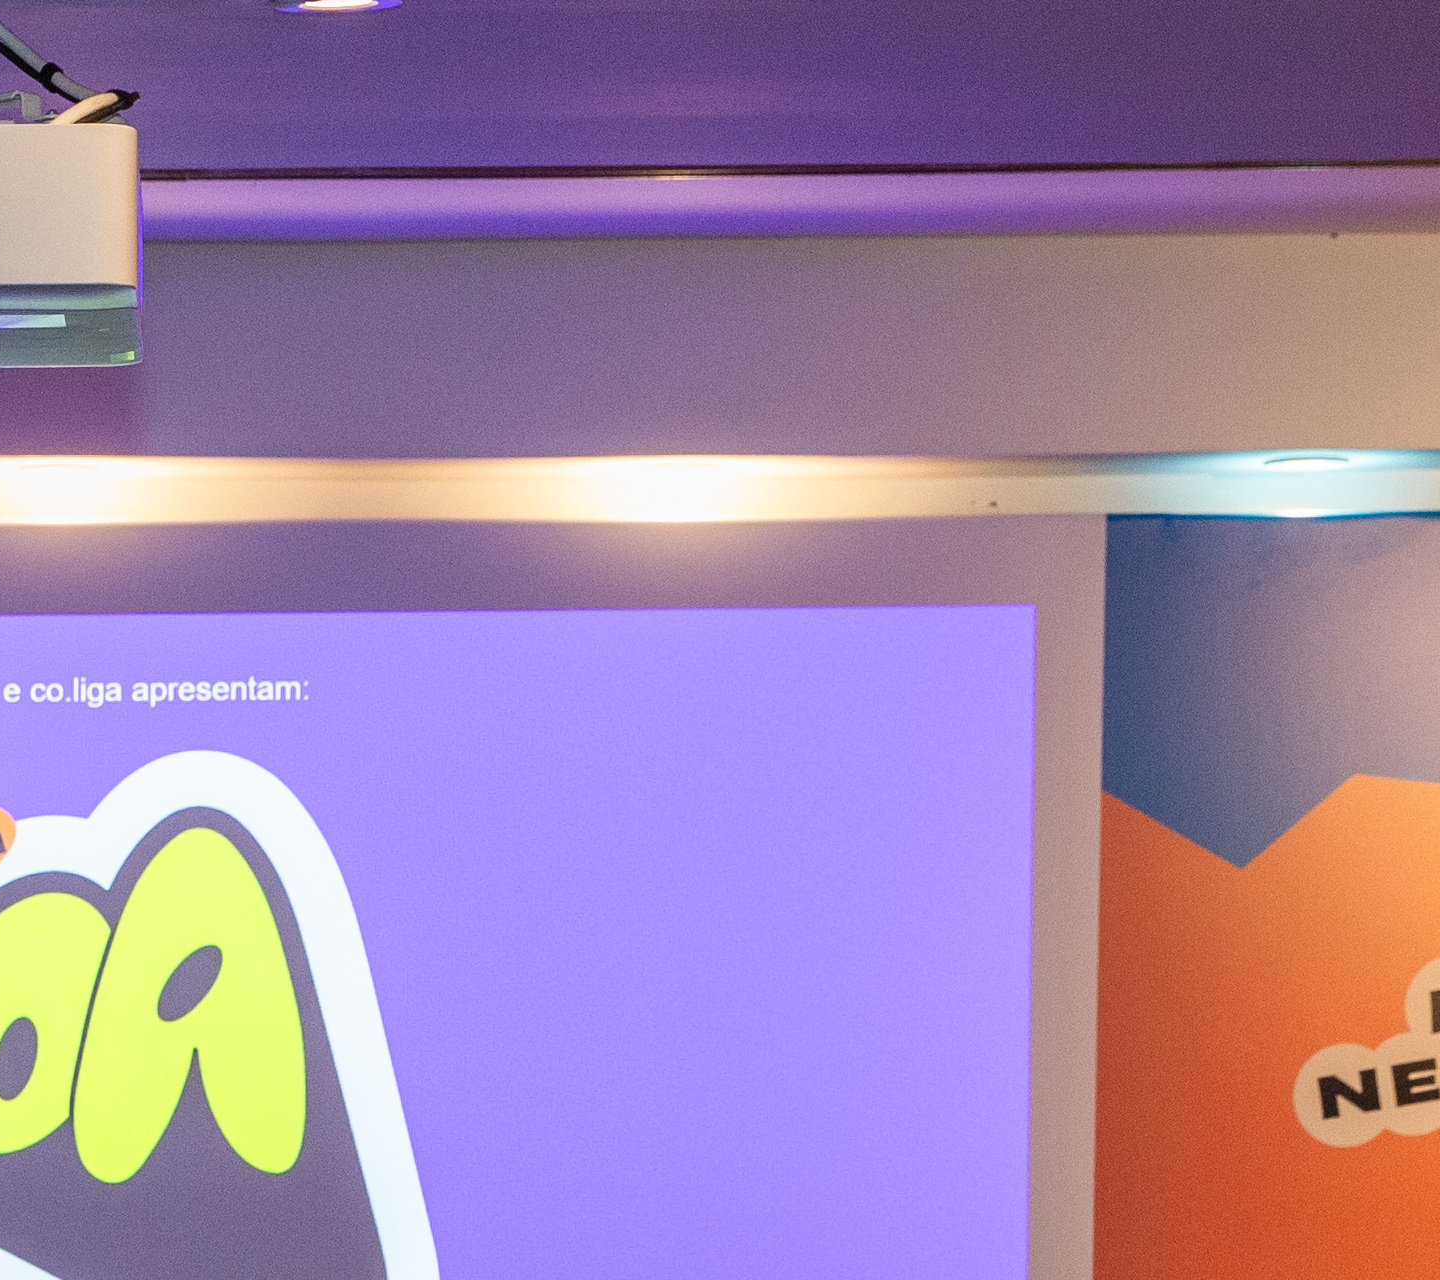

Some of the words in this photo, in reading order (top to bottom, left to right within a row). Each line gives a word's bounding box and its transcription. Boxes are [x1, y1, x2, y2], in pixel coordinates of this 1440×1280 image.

[3, 683, 21, 703] e
[30, 677, 123, 709] co.liga
[132, 677, 310, 708] apresentam:
